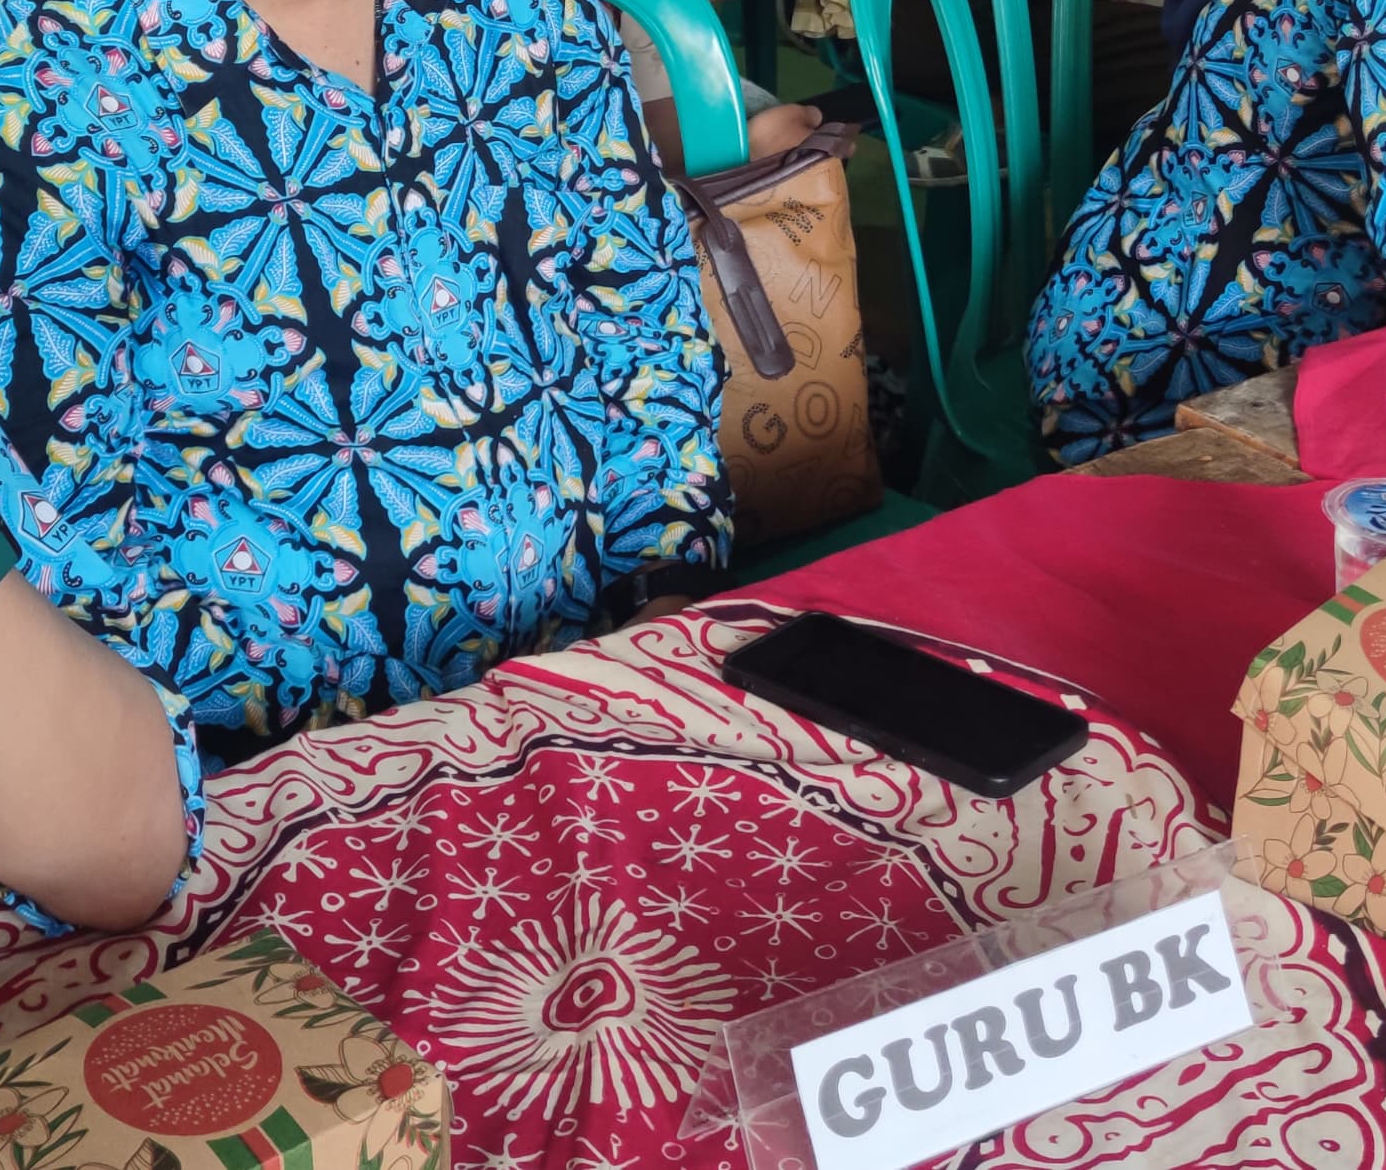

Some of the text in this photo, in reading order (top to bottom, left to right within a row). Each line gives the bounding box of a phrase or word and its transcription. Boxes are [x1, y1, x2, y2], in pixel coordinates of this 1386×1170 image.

[110, 115, 130, 125] YPT
[434, 313, 456, 325] YPT
[187, 378, 211, 390] YPT
[228, 575, 256, 588] YPT
[817, 923, 1232, 1139] GURU BK
[99, 1013, 249, 1093] Menikmati
[144, 1038, 260, 1110] Selamat
